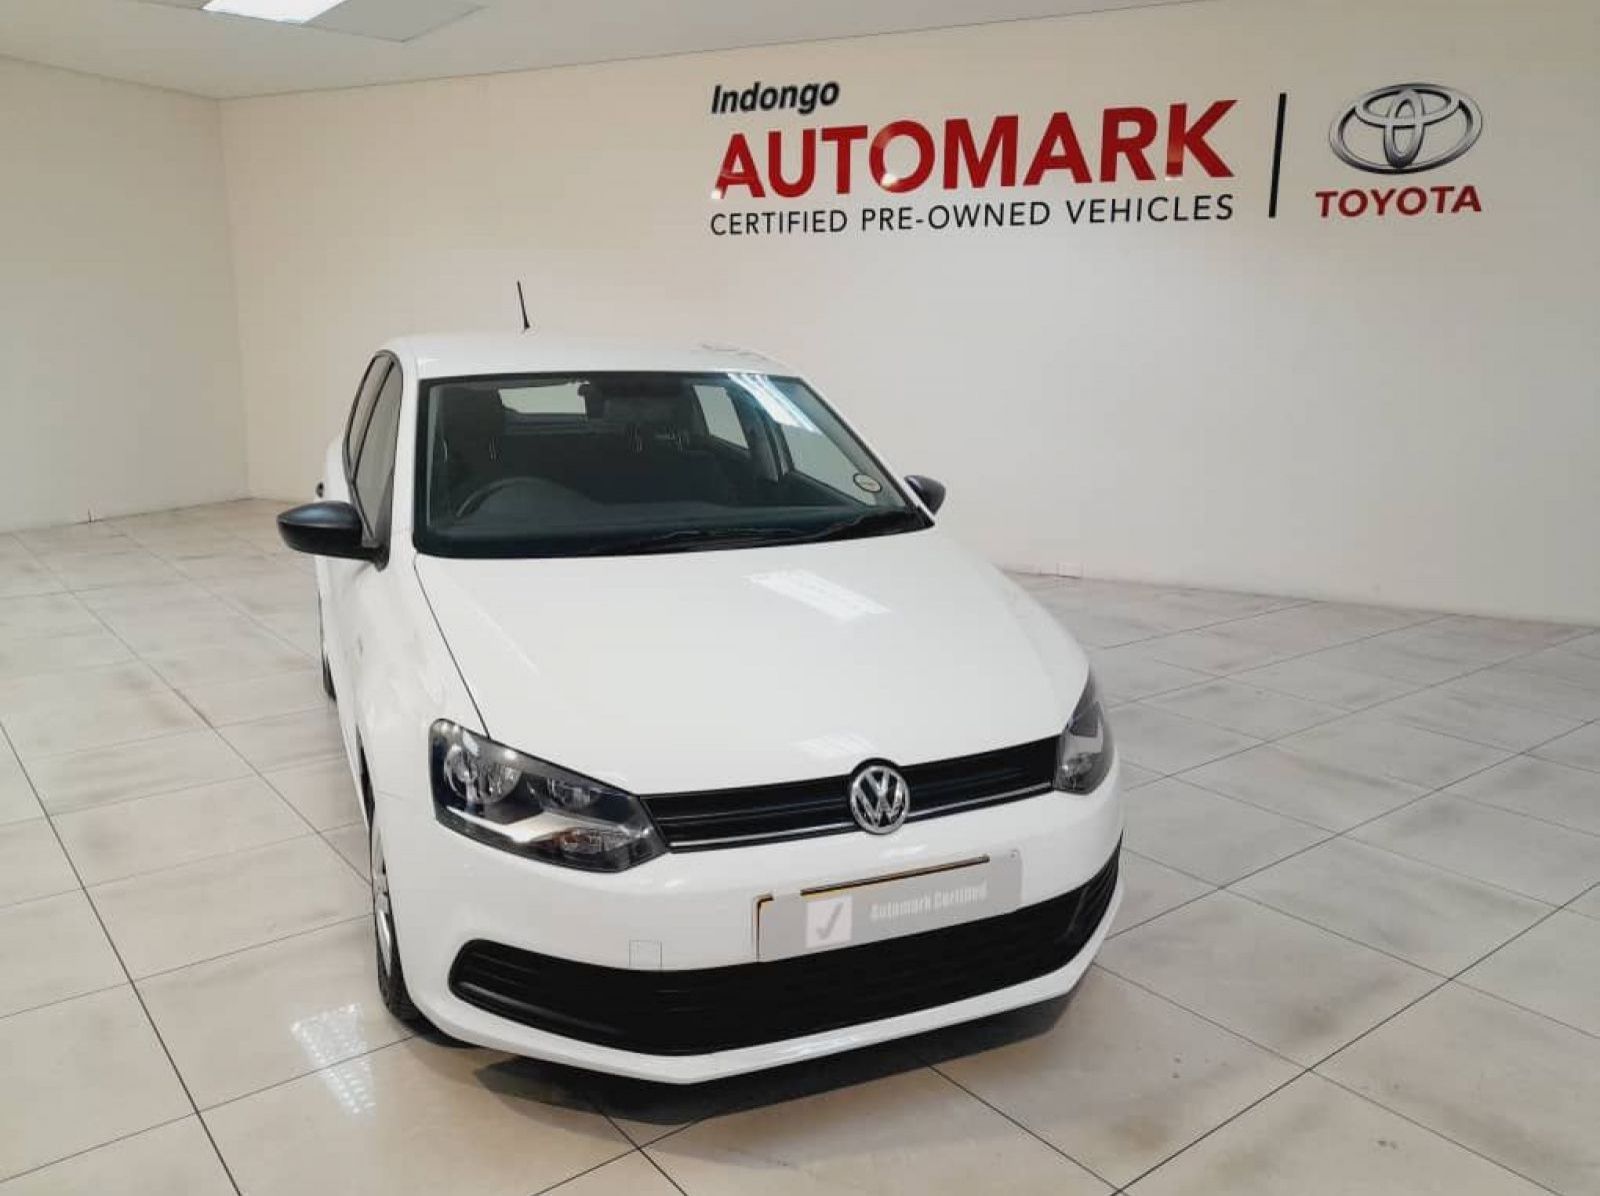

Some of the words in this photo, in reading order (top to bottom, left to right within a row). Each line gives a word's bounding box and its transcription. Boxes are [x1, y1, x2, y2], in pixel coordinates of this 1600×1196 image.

[711, 81, 841, 116] Indongo
[713, 100, 1237, 200] AUTOMARK
[710, 210, 849, 236] CERTIFIED
[861, 202, 1051, 231] PRE-OWNED
[1065, 193, 1235, 225] VEHICLES
[1315, 185, 1482, 218] TOYOTA
